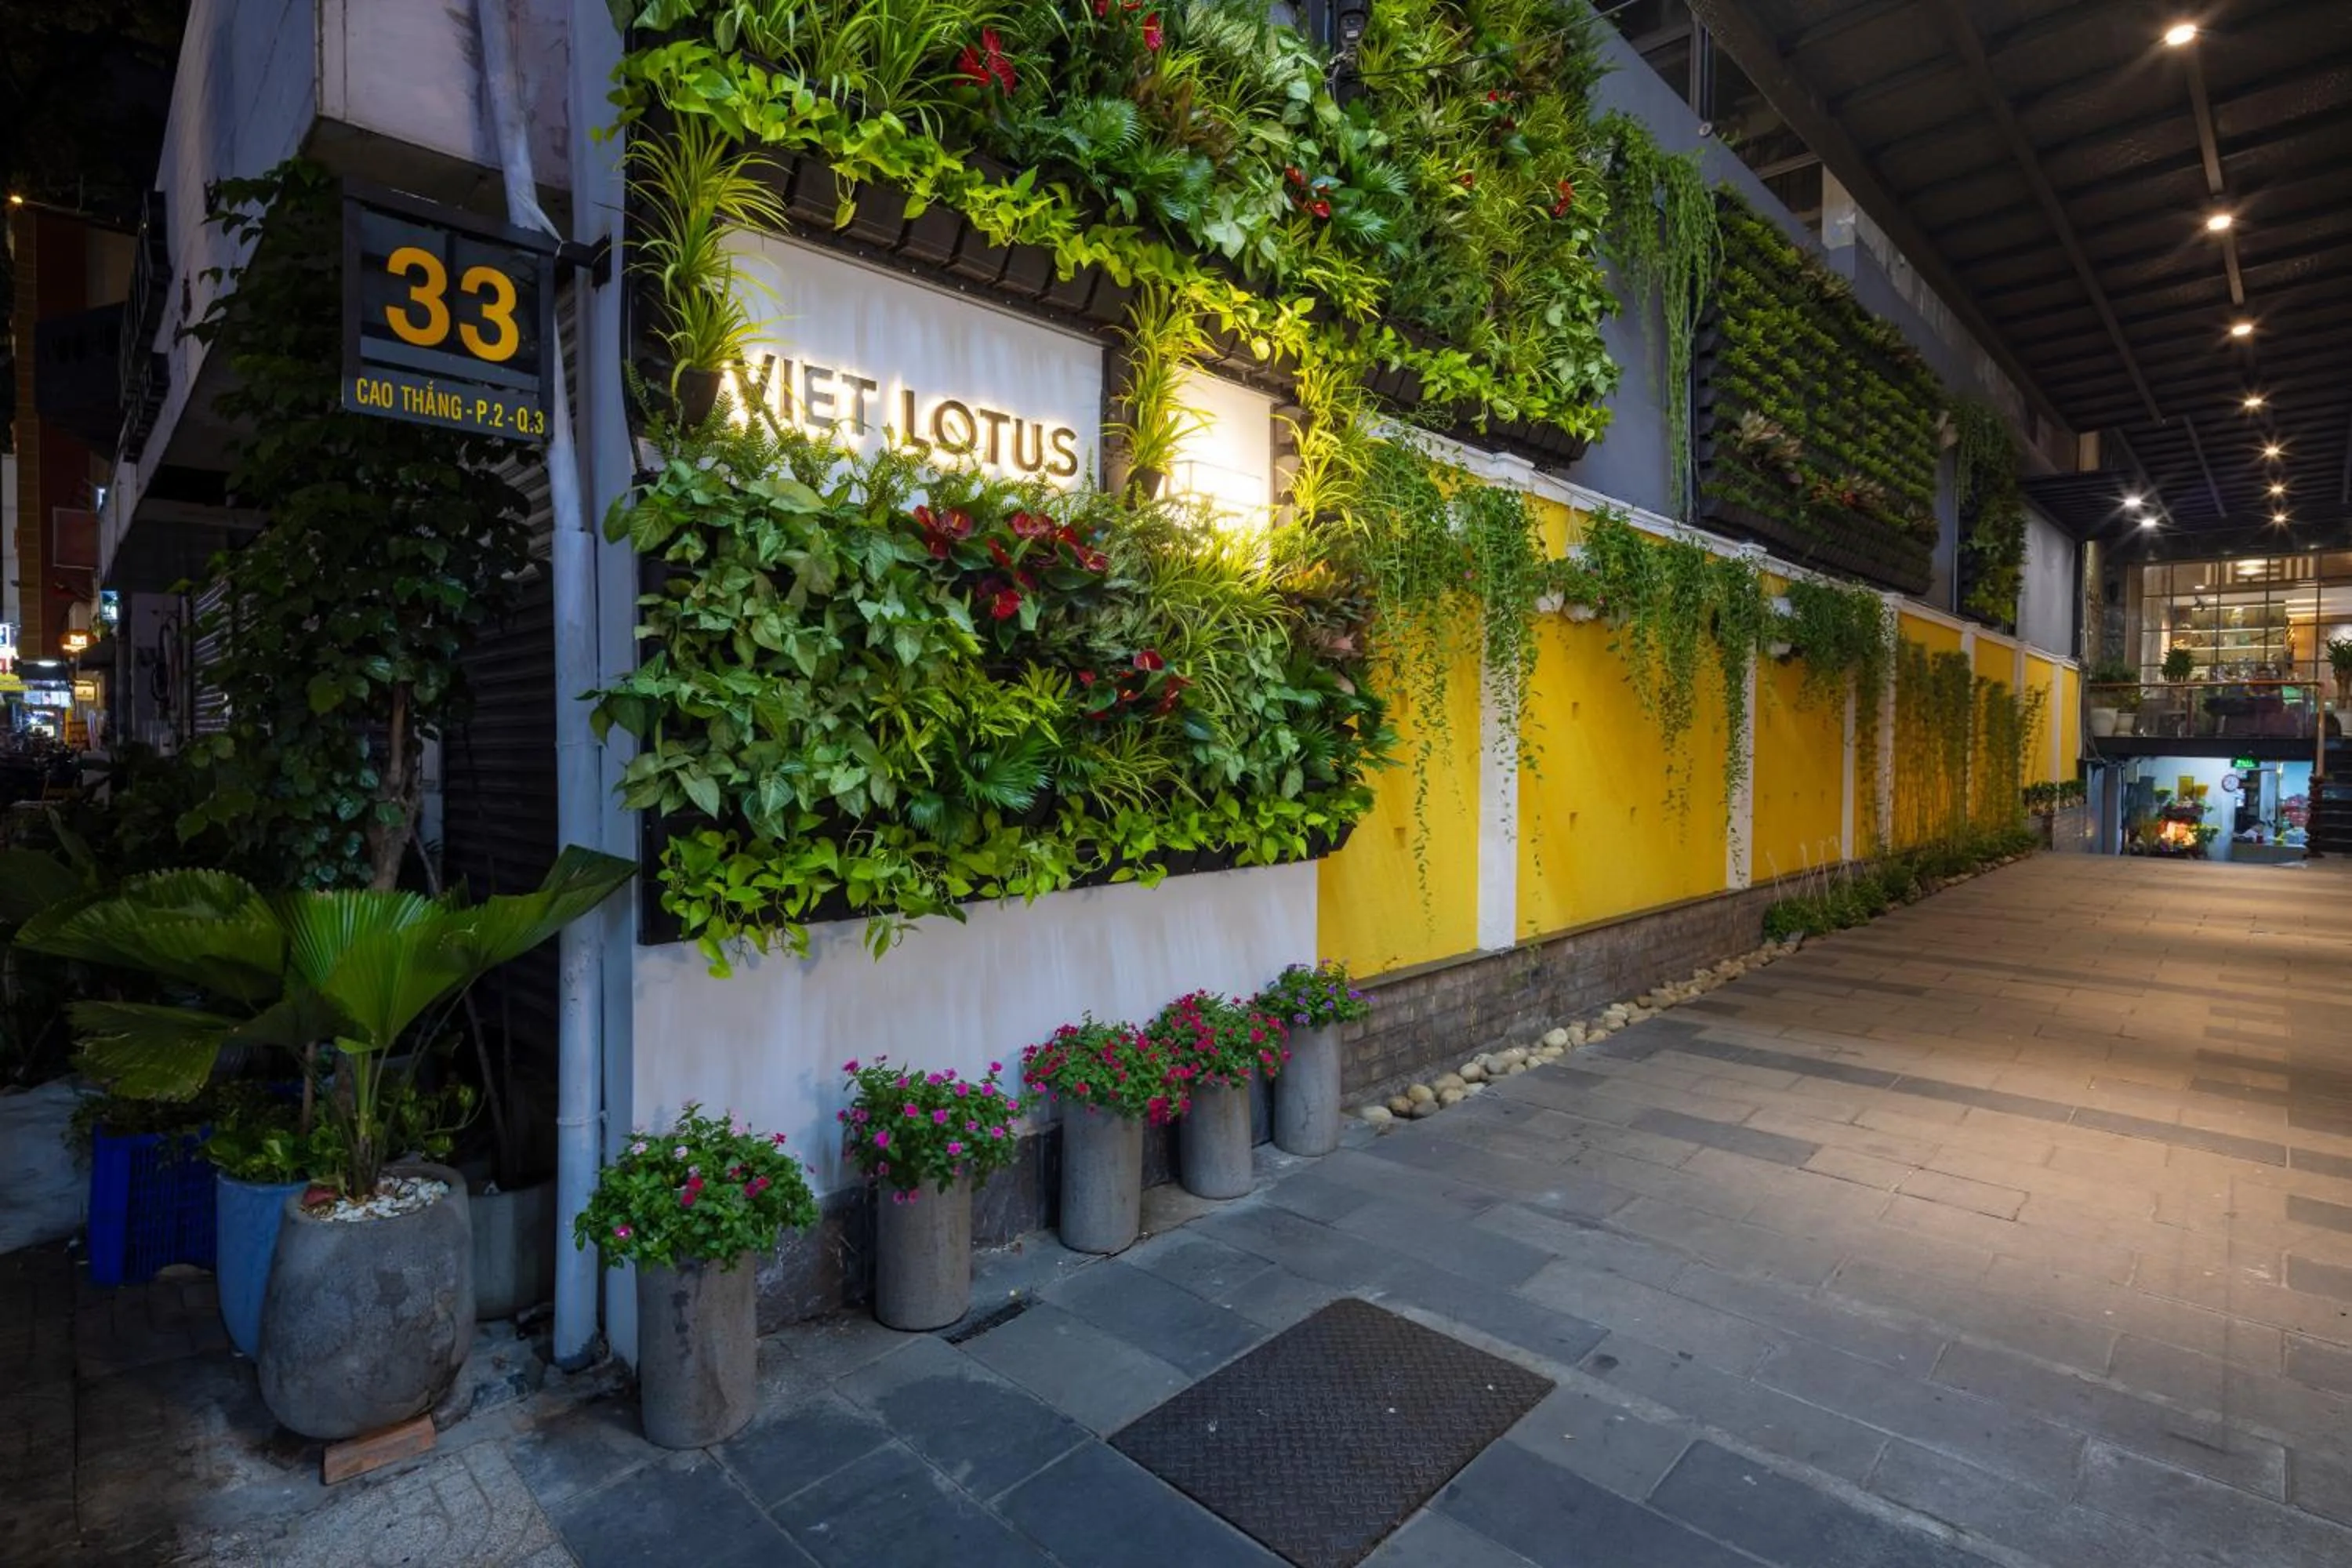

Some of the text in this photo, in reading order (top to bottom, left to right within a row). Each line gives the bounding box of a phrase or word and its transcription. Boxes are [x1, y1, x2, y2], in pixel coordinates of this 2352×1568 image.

[385, 246, 520, 362] 33
[356, 377, 393, 408] CAO
[901, 390, 1078, 477] LOTUS
